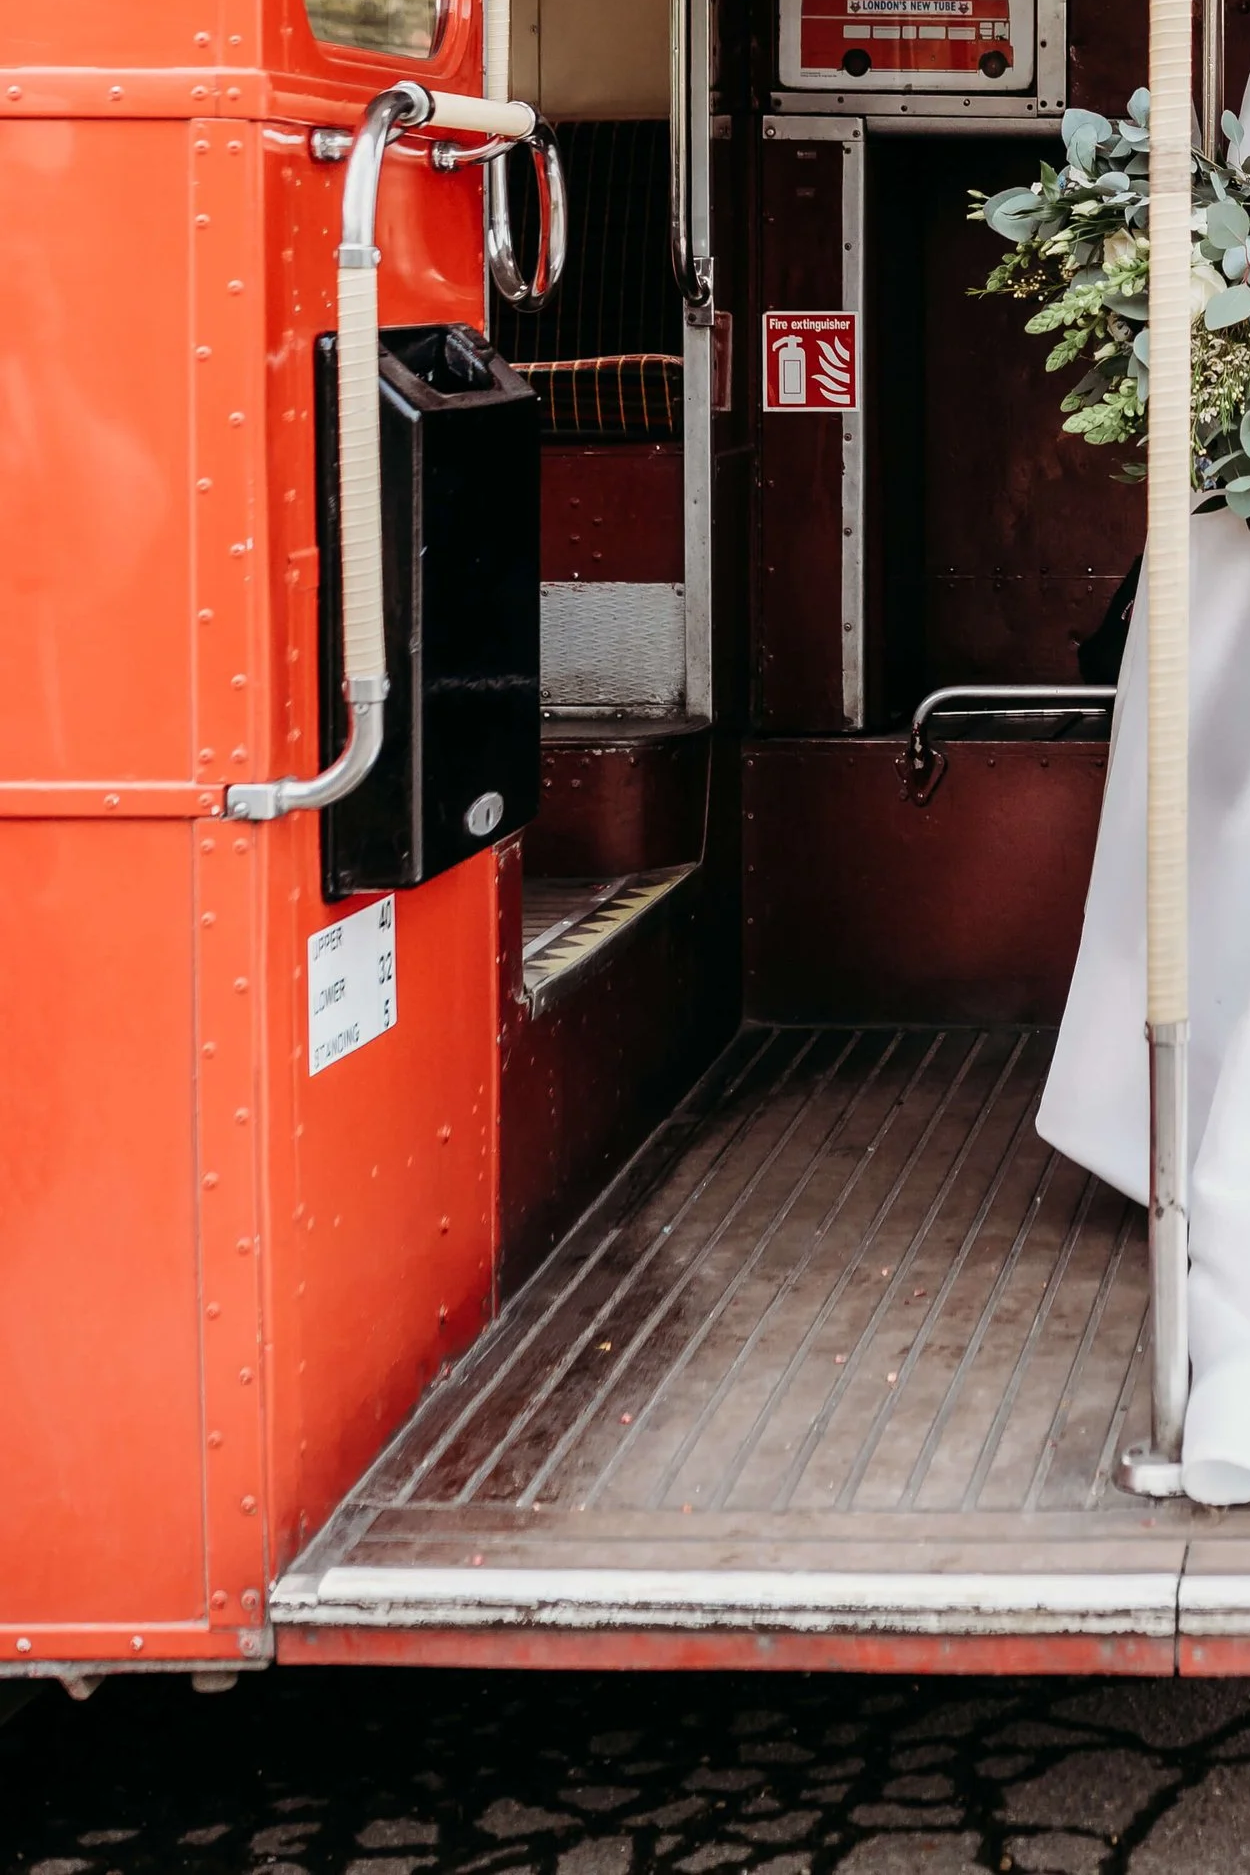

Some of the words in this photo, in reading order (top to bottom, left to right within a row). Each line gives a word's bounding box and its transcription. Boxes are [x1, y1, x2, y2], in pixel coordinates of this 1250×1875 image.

[862, 1, 907, 11] LONDON'S
[910, 1, 930, 11] NEW
[934, 1, 956, 12] TUBE
[769, 318, 788, 329] Fire
[791, 319, 850, 332] extinguisher
[378, 899, 392, 932] 40
[313, 977, 346, 1016] LOWER
[378, 950, 393, 985] 32
[383, 998, 390, 1028] 5
